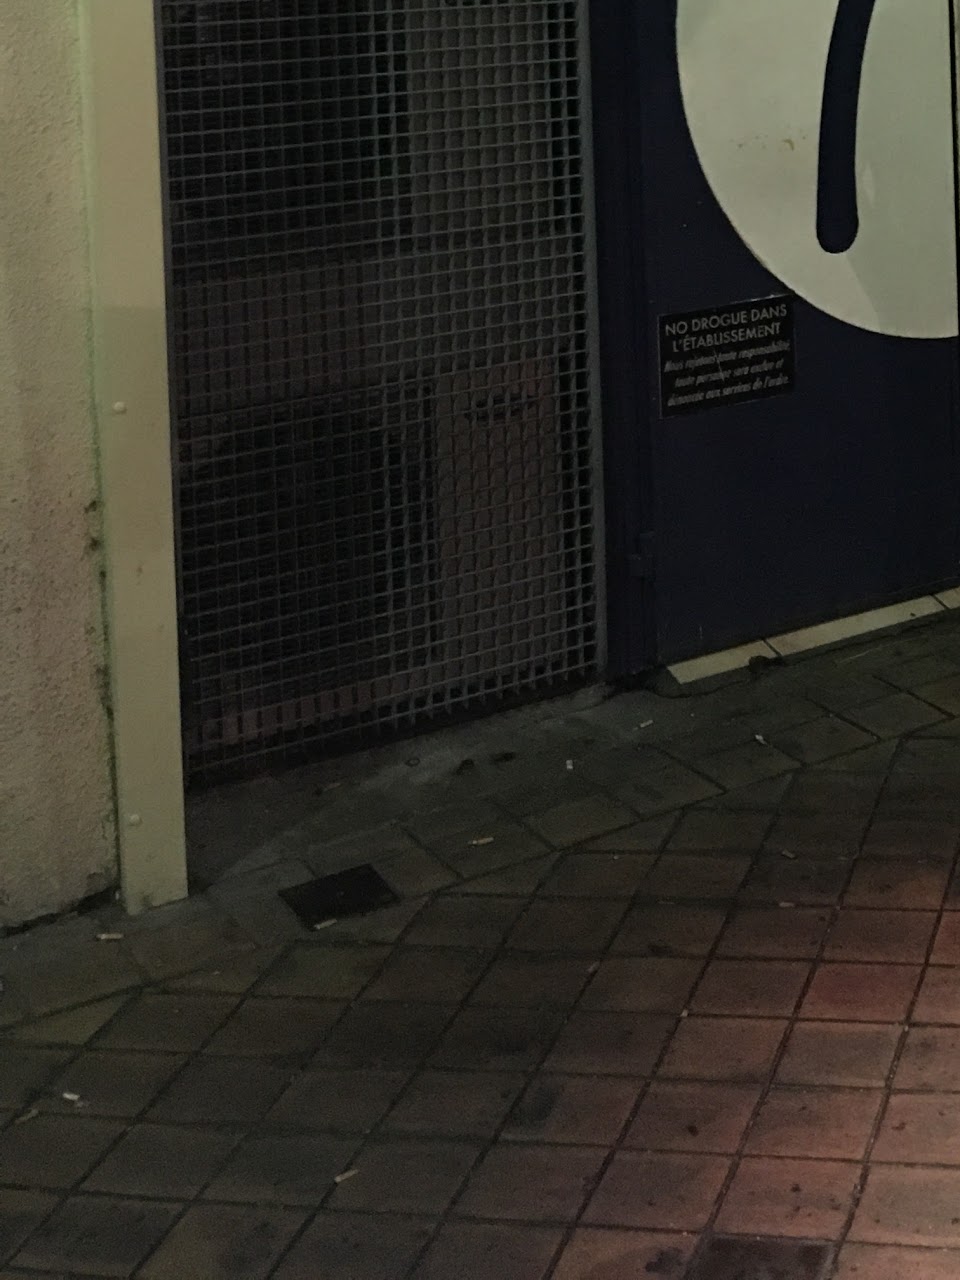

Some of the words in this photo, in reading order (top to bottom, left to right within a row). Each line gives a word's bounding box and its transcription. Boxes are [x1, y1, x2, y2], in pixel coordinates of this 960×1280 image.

[665, 321, 688, 336] NO
[691, 311, 748, 332] DROGUE
[751, 304, 788, 322] DANS
[673, 322, 781, 353] L'ÉTABLISSEMENT
